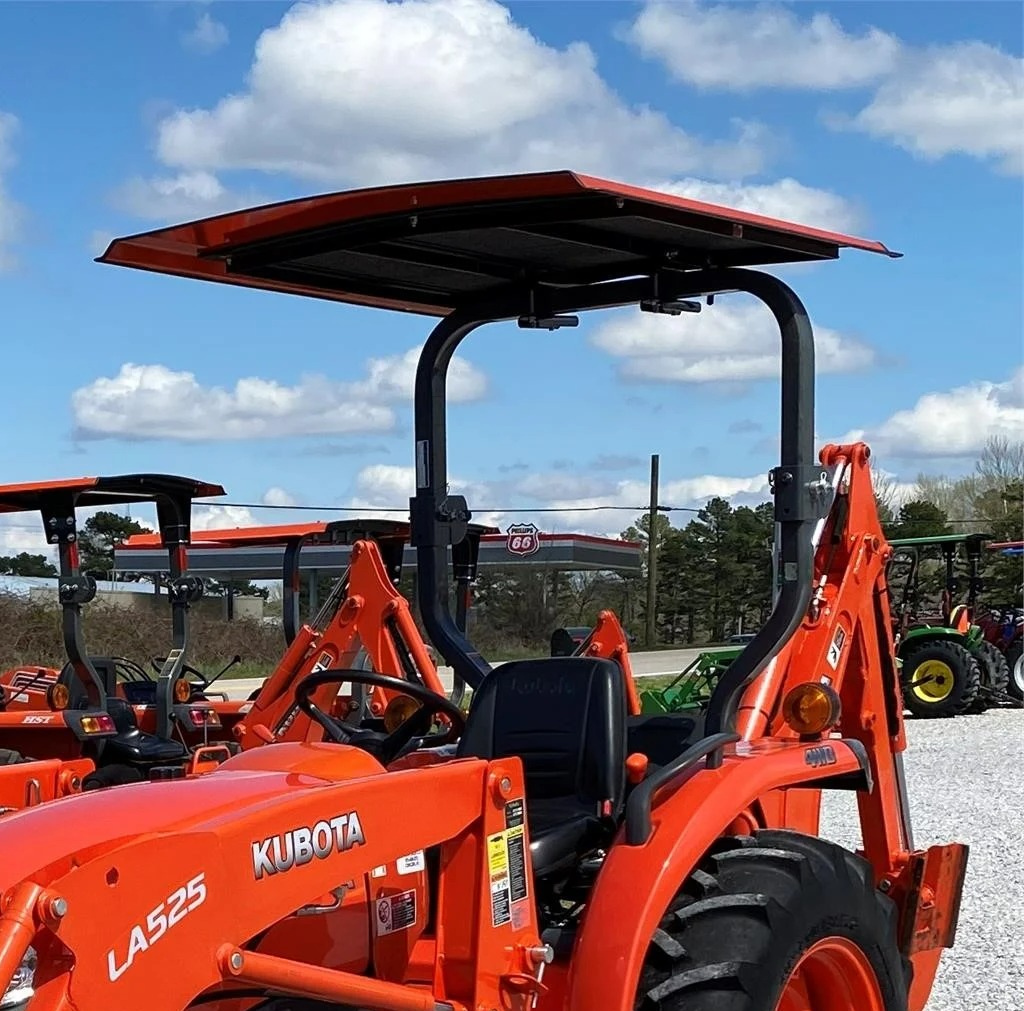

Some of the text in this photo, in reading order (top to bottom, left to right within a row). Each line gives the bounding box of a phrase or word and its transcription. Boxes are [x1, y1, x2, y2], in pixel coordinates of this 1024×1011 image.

[511, 536, 532, 549] 66
[21, 715, 54, 725] HST
[251, 810, 366, 880] KUBOTA
[107, 871, 207, 982] LA525
